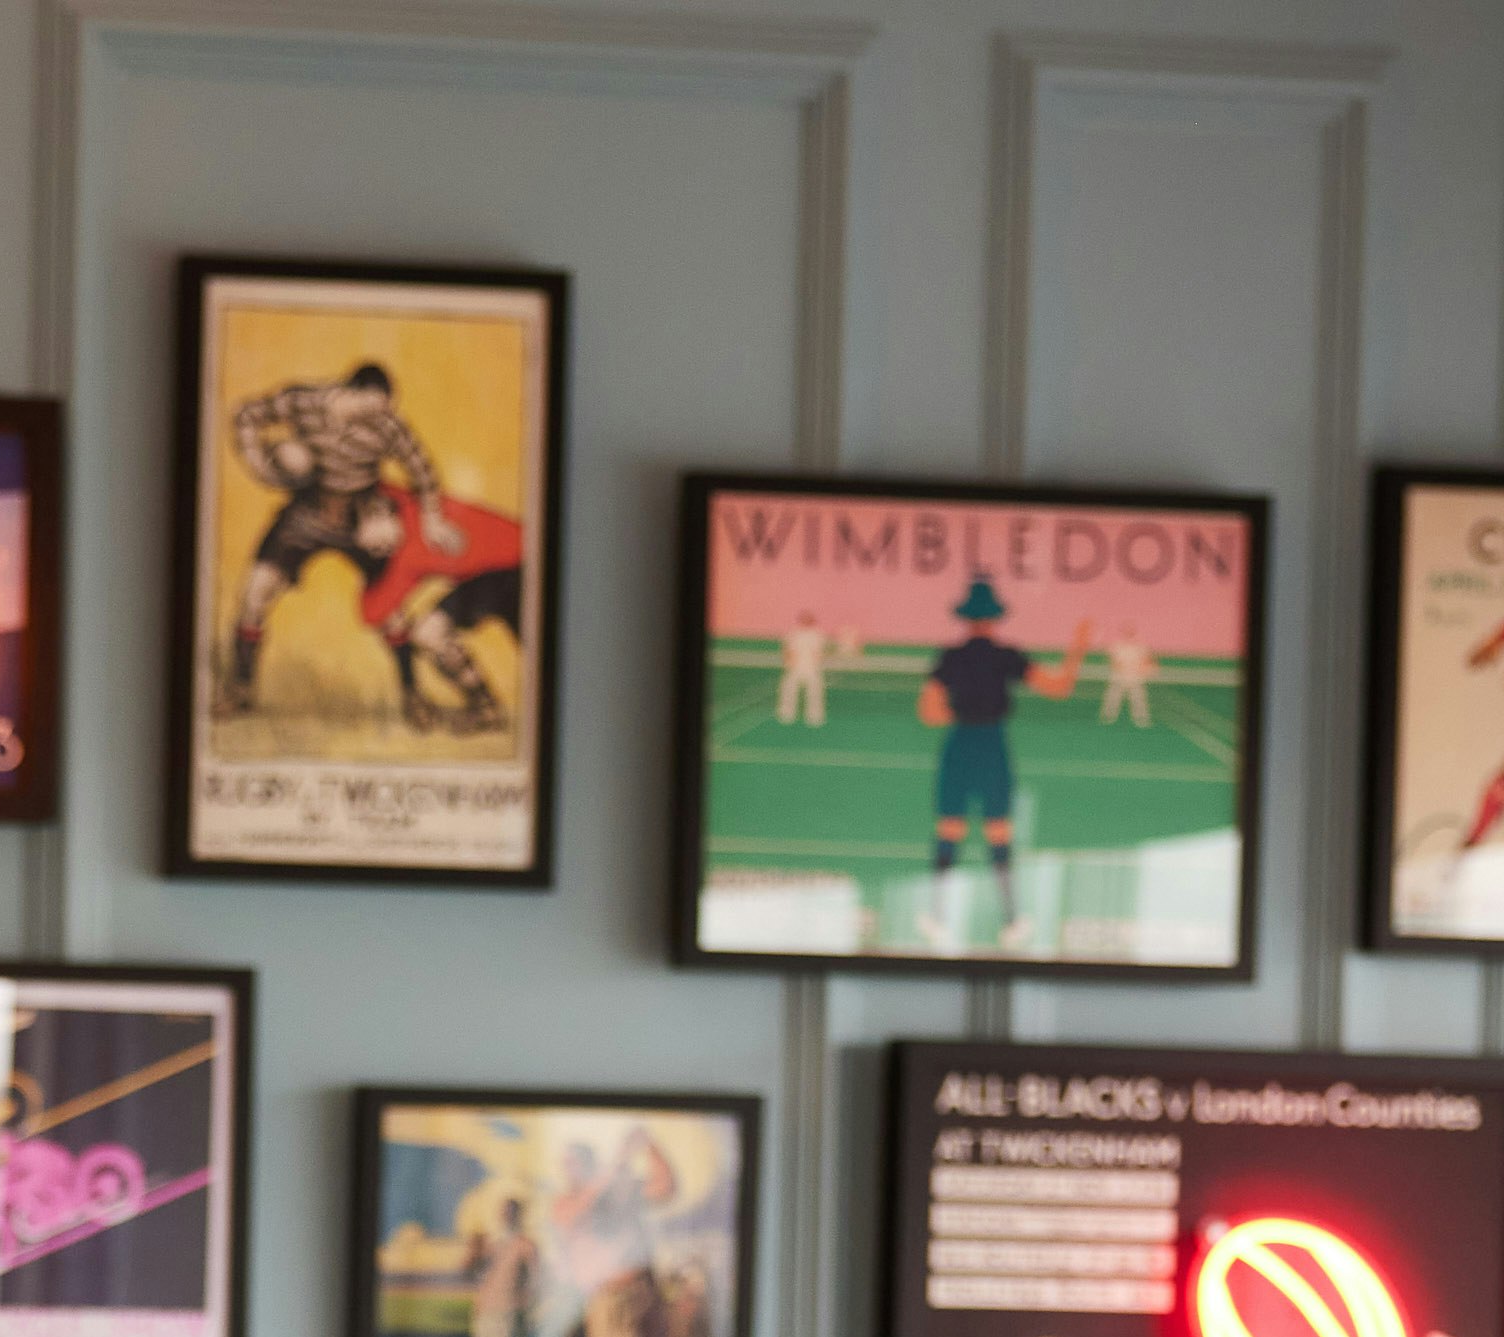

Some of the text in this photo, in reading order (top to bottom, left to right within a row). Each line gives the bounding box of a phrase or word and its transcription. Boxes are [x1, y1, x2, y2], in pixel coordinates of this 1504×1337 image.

[722, 505, 1235, 585] WIMBLEDON
[1194, 1079, 1321, 1126] London
[1325, 1083, 1483, 1131] Counties
